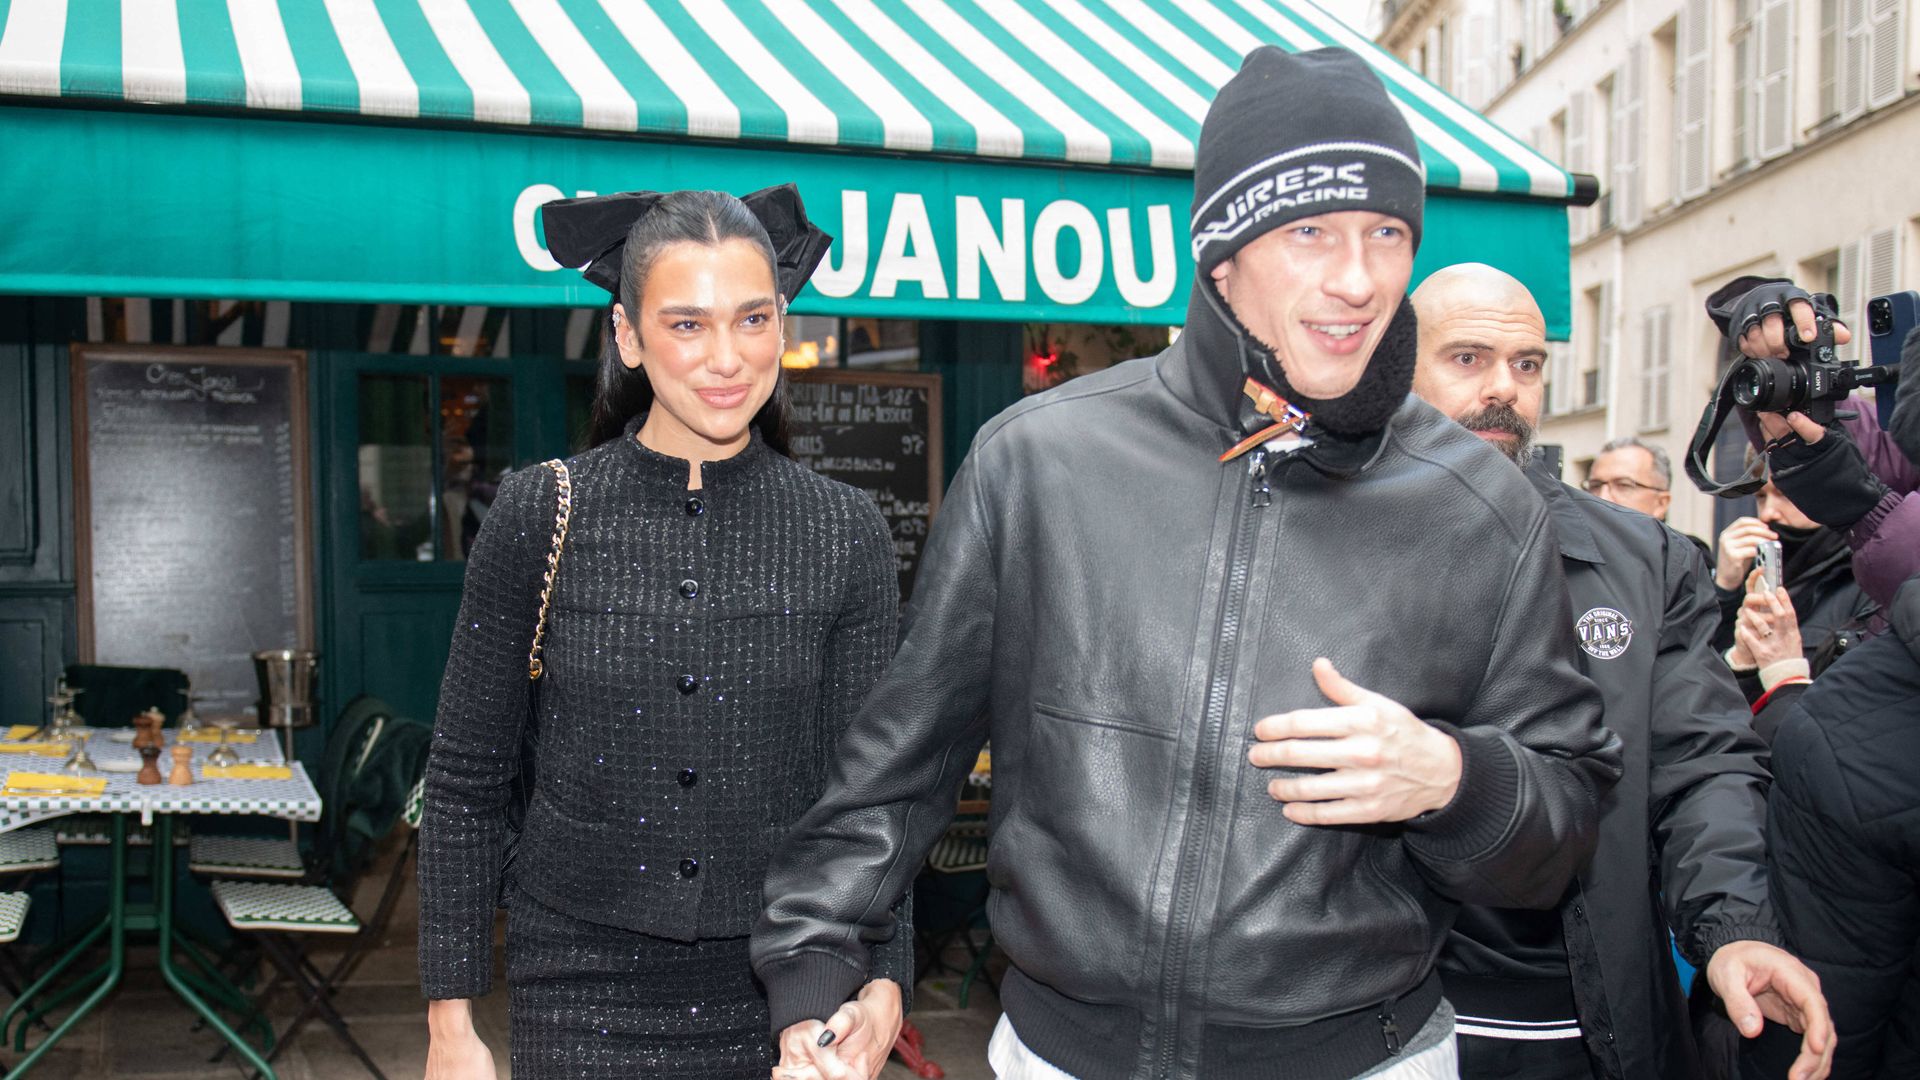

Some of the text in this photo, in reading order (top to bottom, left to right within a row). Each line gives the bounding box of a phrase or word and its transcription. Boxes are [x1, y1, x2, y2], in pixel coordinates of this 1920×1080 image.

[1255, 187, 1368, 222] RACING
[811, 190, 1177, 308] JANOU
[1579, 623, 1628, 641] VANS
[1609, 644, 1623, 655] WALL
